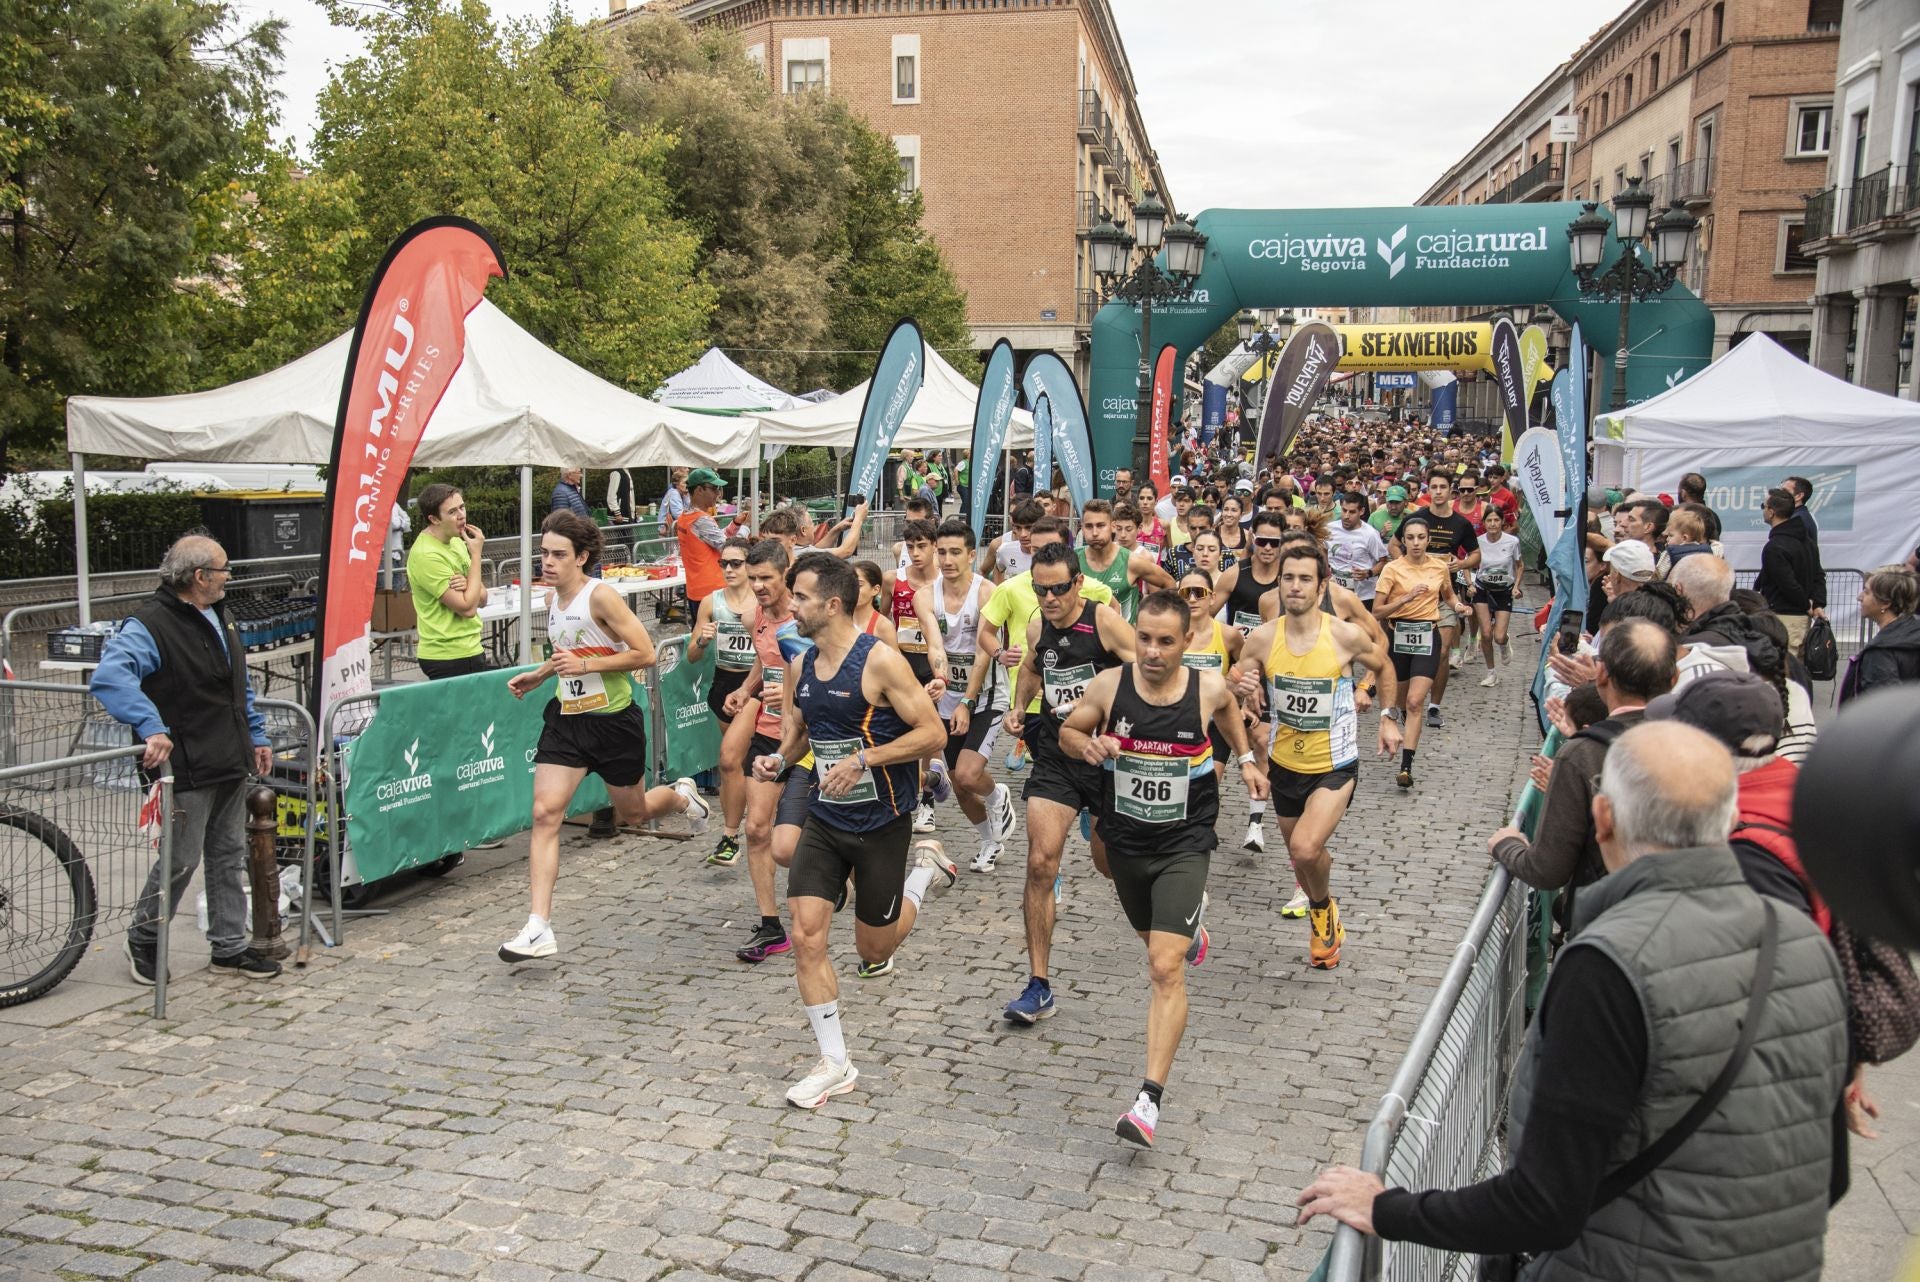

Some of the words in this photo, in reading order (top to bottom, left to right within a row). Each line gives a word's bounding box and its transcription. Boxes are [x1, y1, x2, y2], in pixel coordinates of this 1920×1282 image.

[1249, 233, 1367, 264] cajaviva
[1416, 227, 1548, 259] cajarural
[1301, 258, 1366, 273] Segovia
[1415, 254, 1510, 269] Fundación
[1361, 331, 1477, 359] SEXMEROS
[1379, 375, 1414, 385] META
[390, 344, 440, 438] BERRIES
[1705, 486, 1745, 511] YOU
[728, 636, 752, 651] 207
[1405, 633, 1422, 644] 131
[951, 666, 968, 681] 94
[675, 701, 709, 721] cajaviva
[1286, 694, 1318, 714] 292
[1133, 740, 1173, 754] SPARTANS
[456, 756, 505, 782] cajaviva
[376, 773, 432, 801] cajaviva
[1131, 777, 1171, 802] 266
